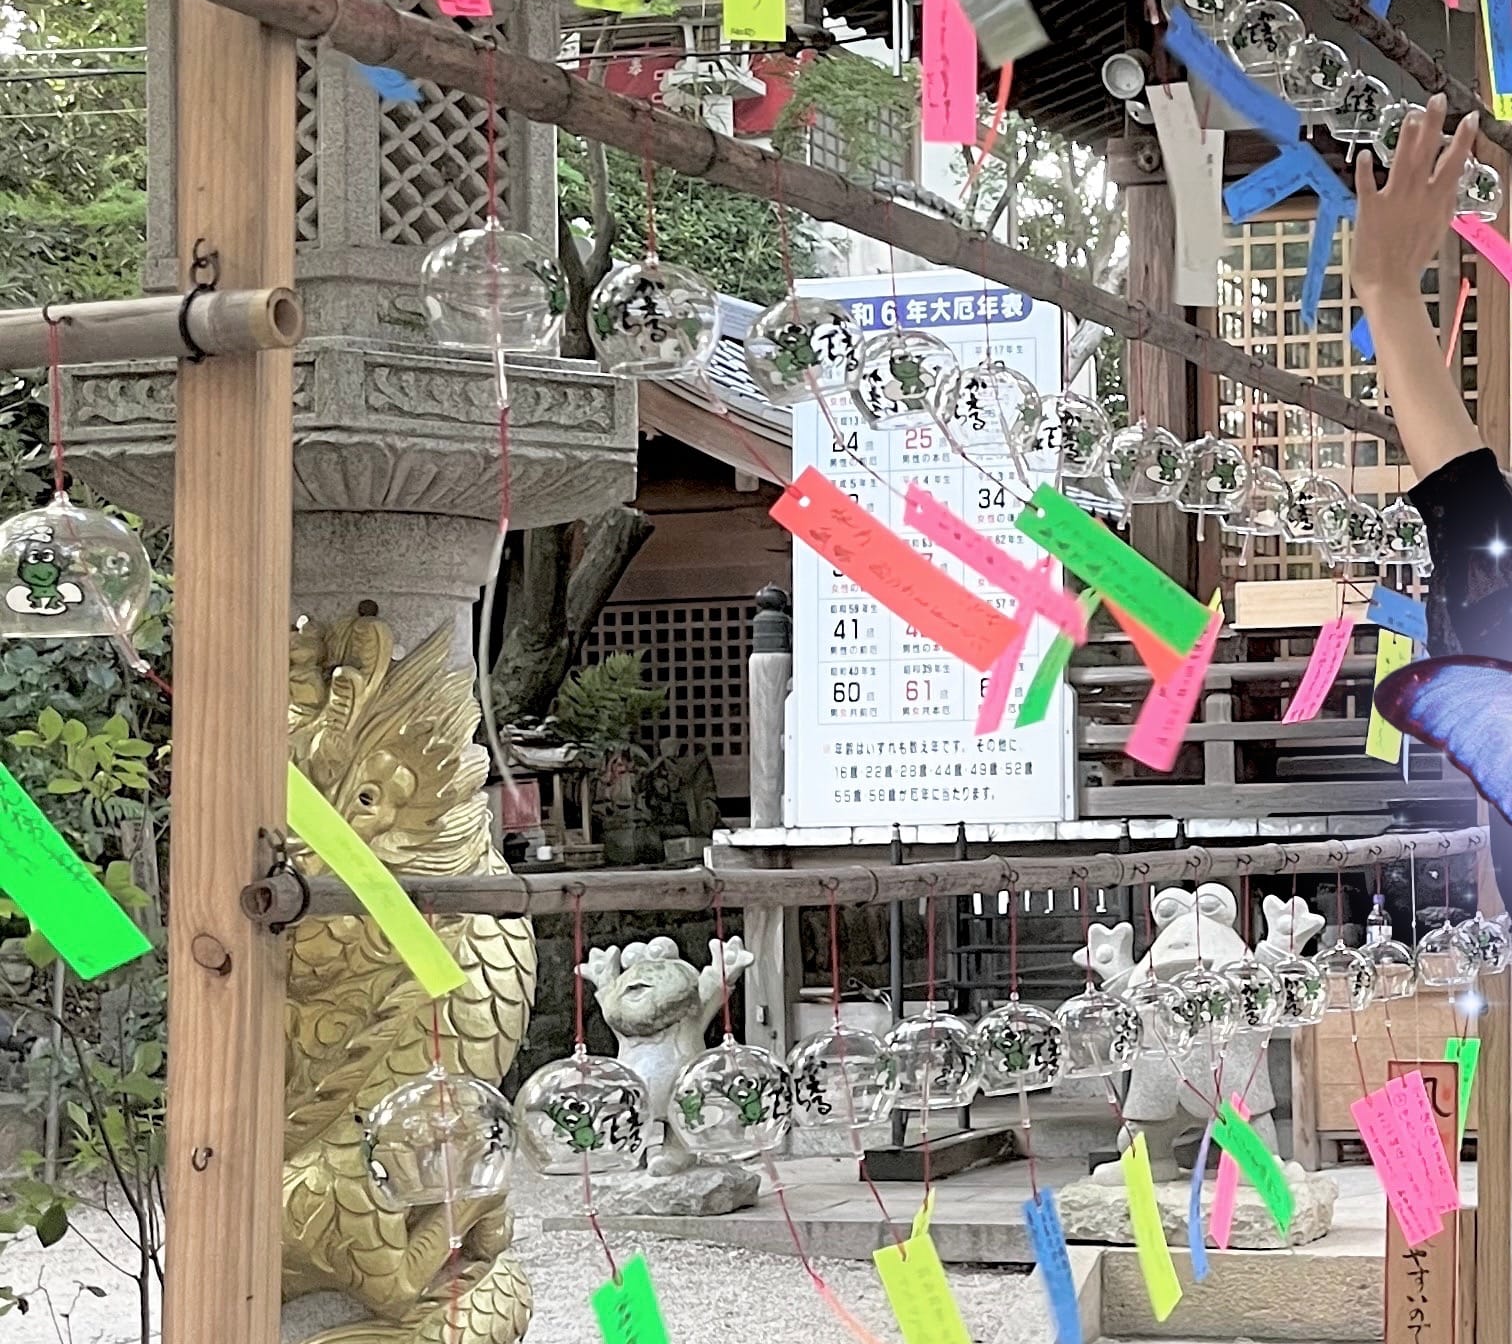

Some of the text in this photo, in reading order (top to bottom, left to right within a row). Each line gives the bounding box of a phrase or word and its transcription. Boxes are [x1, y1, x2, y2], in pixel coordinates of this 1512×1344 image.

[851, 293, 1025, 326] 和6年大厄年表
